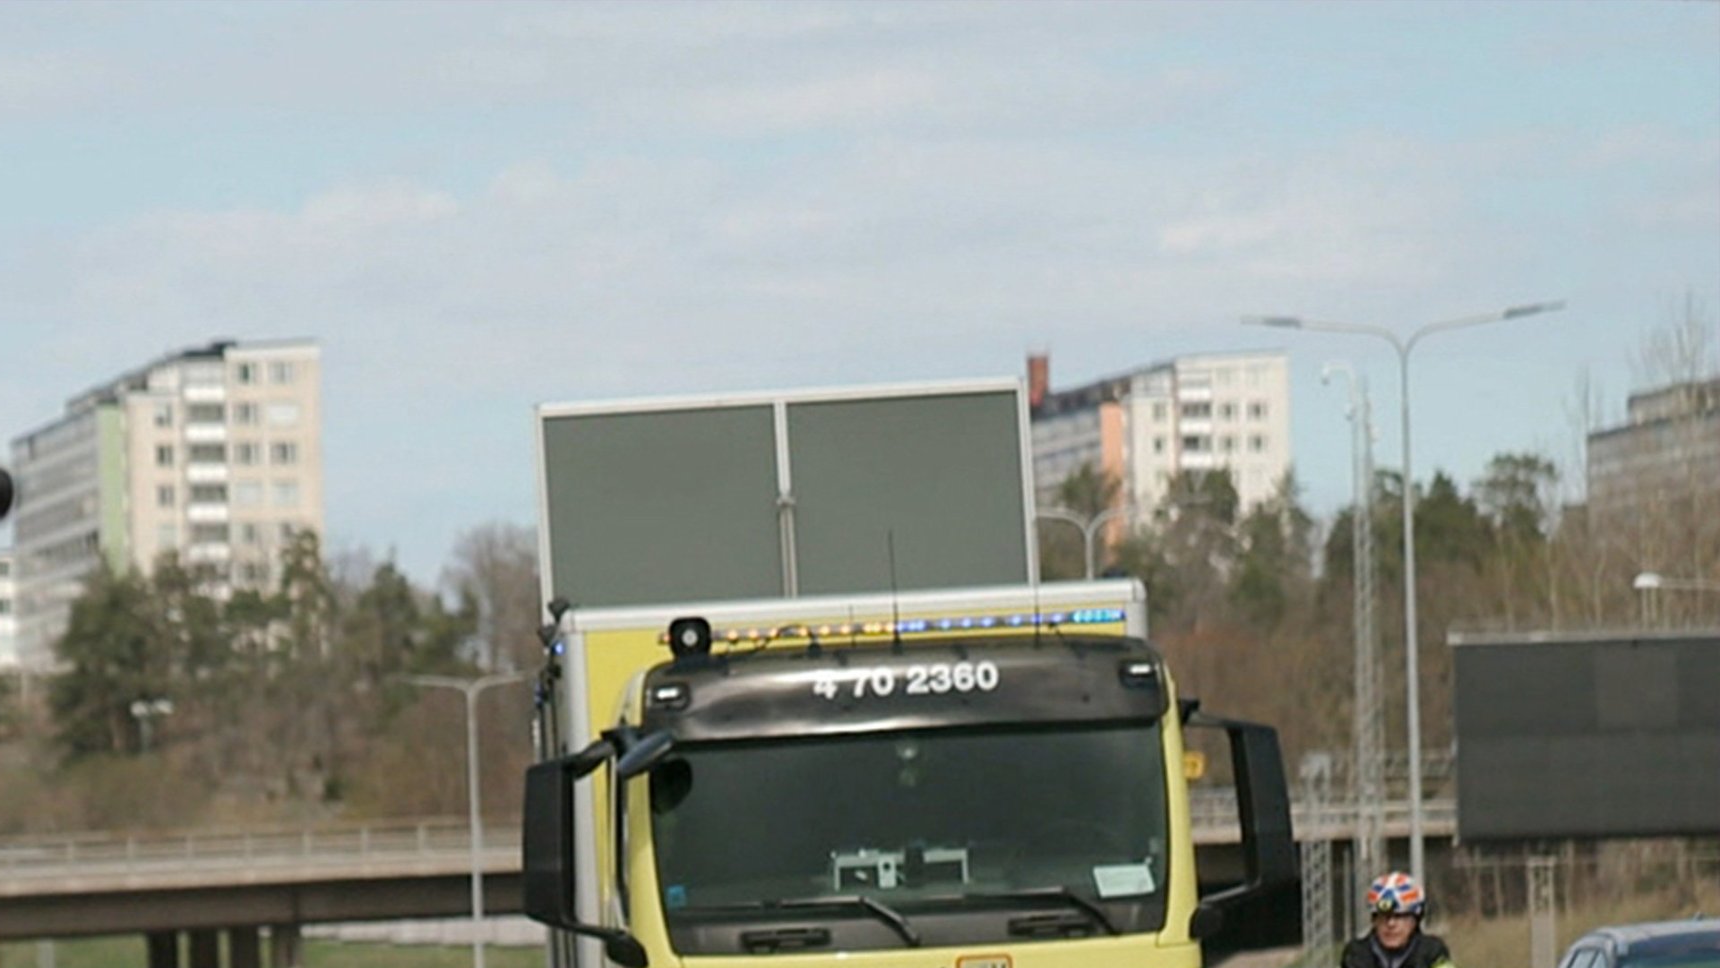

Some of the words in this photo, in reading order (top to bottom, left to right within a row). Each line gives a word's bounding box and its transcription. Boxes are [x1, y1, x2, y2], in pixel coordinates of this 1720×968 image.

[813, 668, 839, 699] 4
[853, 667, 895, 698] 70
[906, 660, 999, 694] 2360
